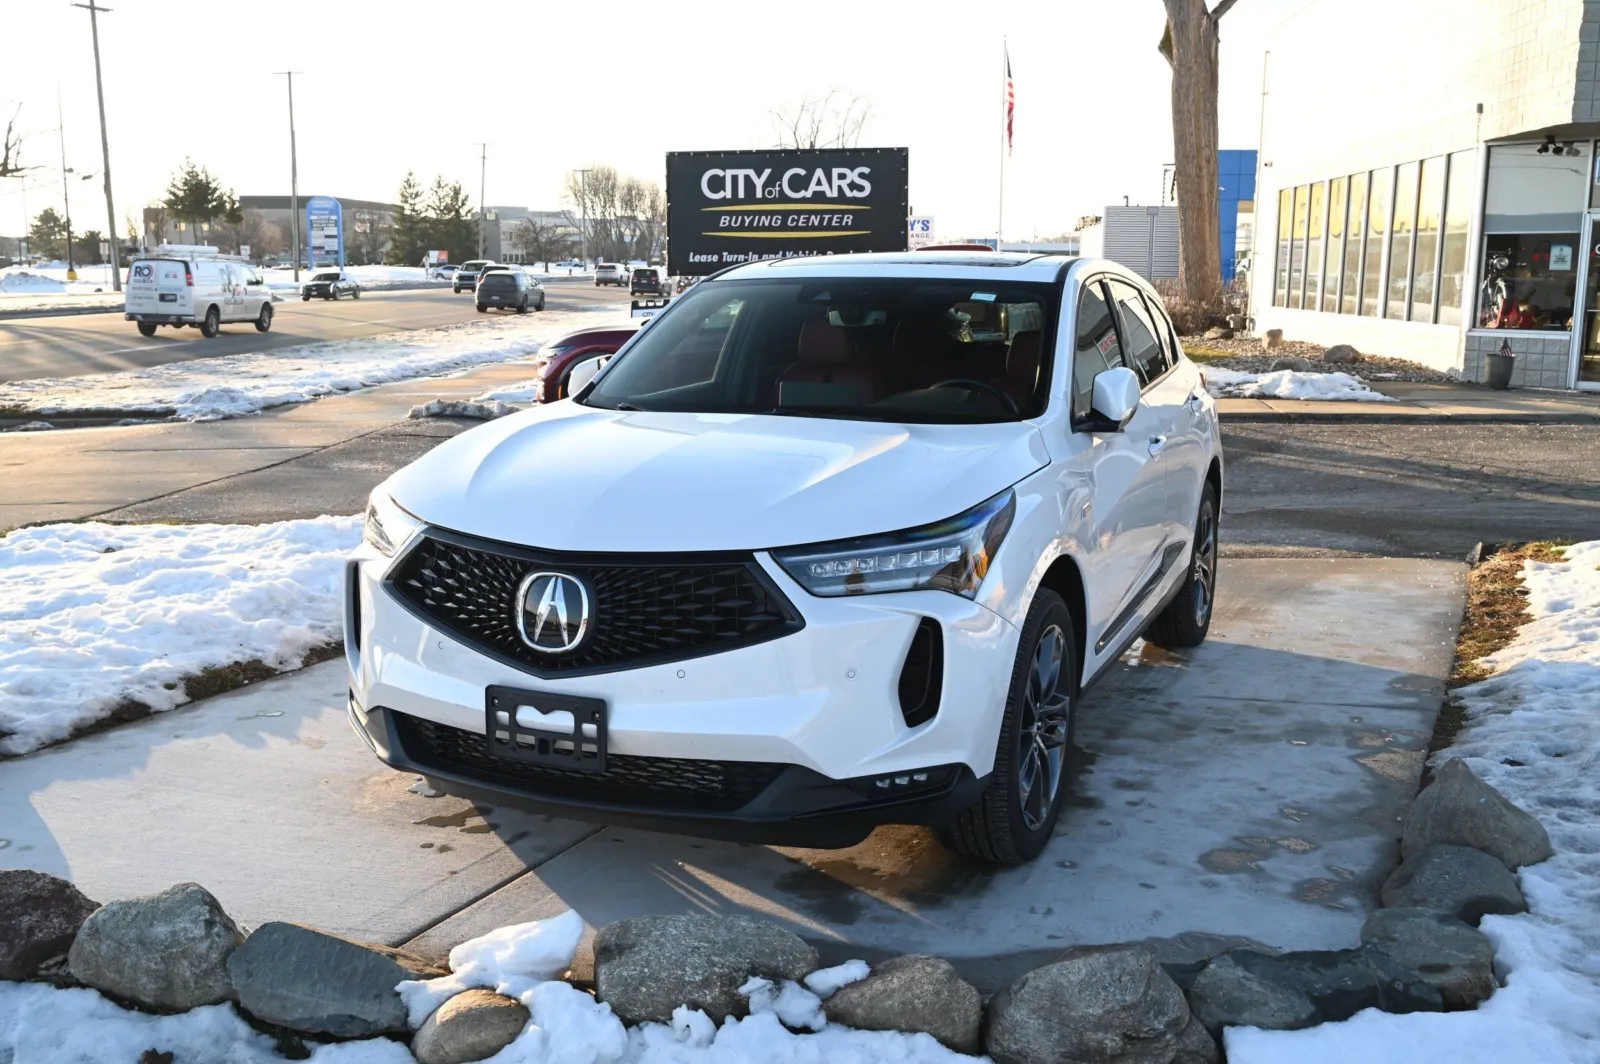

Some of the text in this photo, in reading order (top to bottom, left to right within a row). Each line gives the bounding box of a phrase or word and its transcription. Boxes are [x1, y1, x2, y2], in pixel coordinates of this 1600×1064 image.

[700, 166, 872, 200] CITY of CARS
[719, 214, 853, 228] BUYING CENTER
[689, 252, 719, 262] Lease
[722, 252, 759, 262] Turn-In
